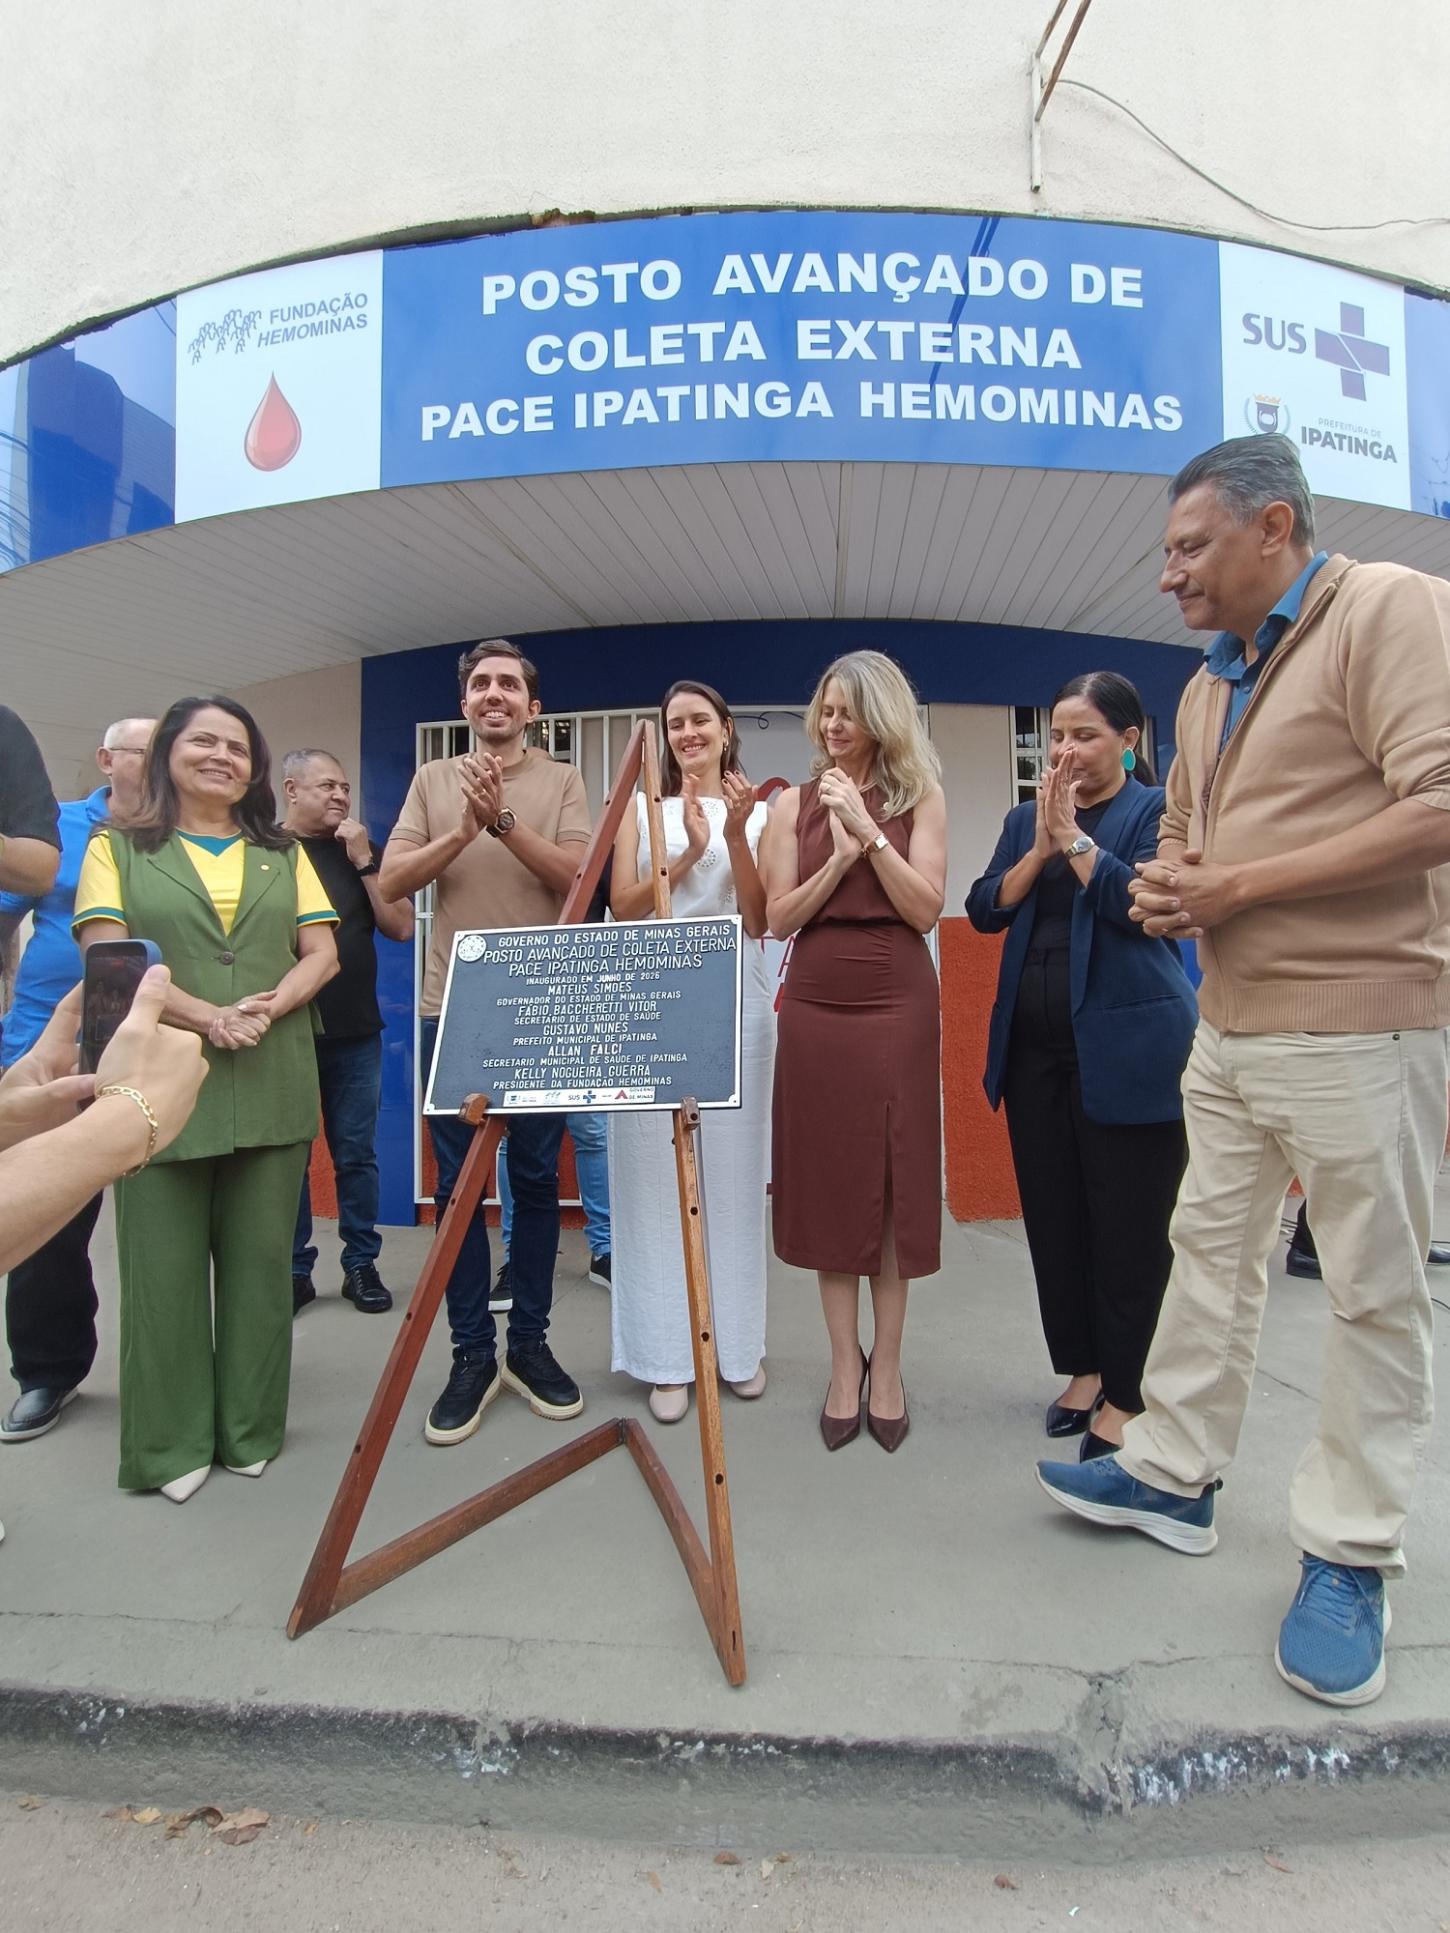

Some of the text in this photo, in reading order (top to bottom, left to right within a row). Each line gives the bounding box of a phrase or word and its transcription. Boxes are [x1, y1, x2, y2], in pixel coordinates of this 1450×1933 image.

[482, 252, 1143, 315] POSTO AVANÇADO DE
[270, 292, 368, 324] FUNDAÇÃO
[257, 313, 368, 348] HEMOMINAS
[1242, 312, 1307, 354] SUS
[526, 320, 1082, 375] COLETA EXTERNA
[421, 381, 1183, 441] PACE IPATINGA HEMOMINAS
[1318, 417, 1381, 438] PREFEITURA DE
[1301, 426, 1398, 463] IPATINGA
[499, 925, 730, 947] GOVERNO DO ESTADO DE MINAS GERAIS
[484, 937, 736, 963] POSTO AVANÇADO DE COLETA EXTERNA
[509, 954, 702, 977] PACE IPATINGA HEMOMINAS
[526, 971, 660, 985] INAUGURADO EM JUNHO DE 2026
[497, 996, 550, 1006] GOVERNADOR
[555, 996, 566, 1004] DO
[570, 995, 601, 1003] ESTADO
[605, 994, 615, 1002] DE
[651, 991, 681, 999] GERAIS
[548, 984, 588, 995] MATEUS
[554, 1002, 622, 1014] BACCHERETTI
[629, 1001, 657, 1011] VITOR
[570, 1015, 580, 1023] DE
[586, 1014, 616, 1022] ESTADO
[543, 1022, 628, 1035] GUSTAVO NUNES
[513, 1033, 657, 1045] PREFEITO MUNICIPAL DE IPATINGA
[548, 1044, 622, 1056] ALLAN FALCI
[540, 1057, 585, 1066] MUNICIPAL
[589, 1056, 601, 1064] DE
[650, 1053, 687, 1062] IPATINGA
[514, 1065, 650, 1079] KELLY NOGUEIRA GUERRA
[493, 1080, 546, 1089] PRESIDENTE
[551, 1080, 562, 1088] DA
[619, 1077, 672, 1086] HEMOMINAS
